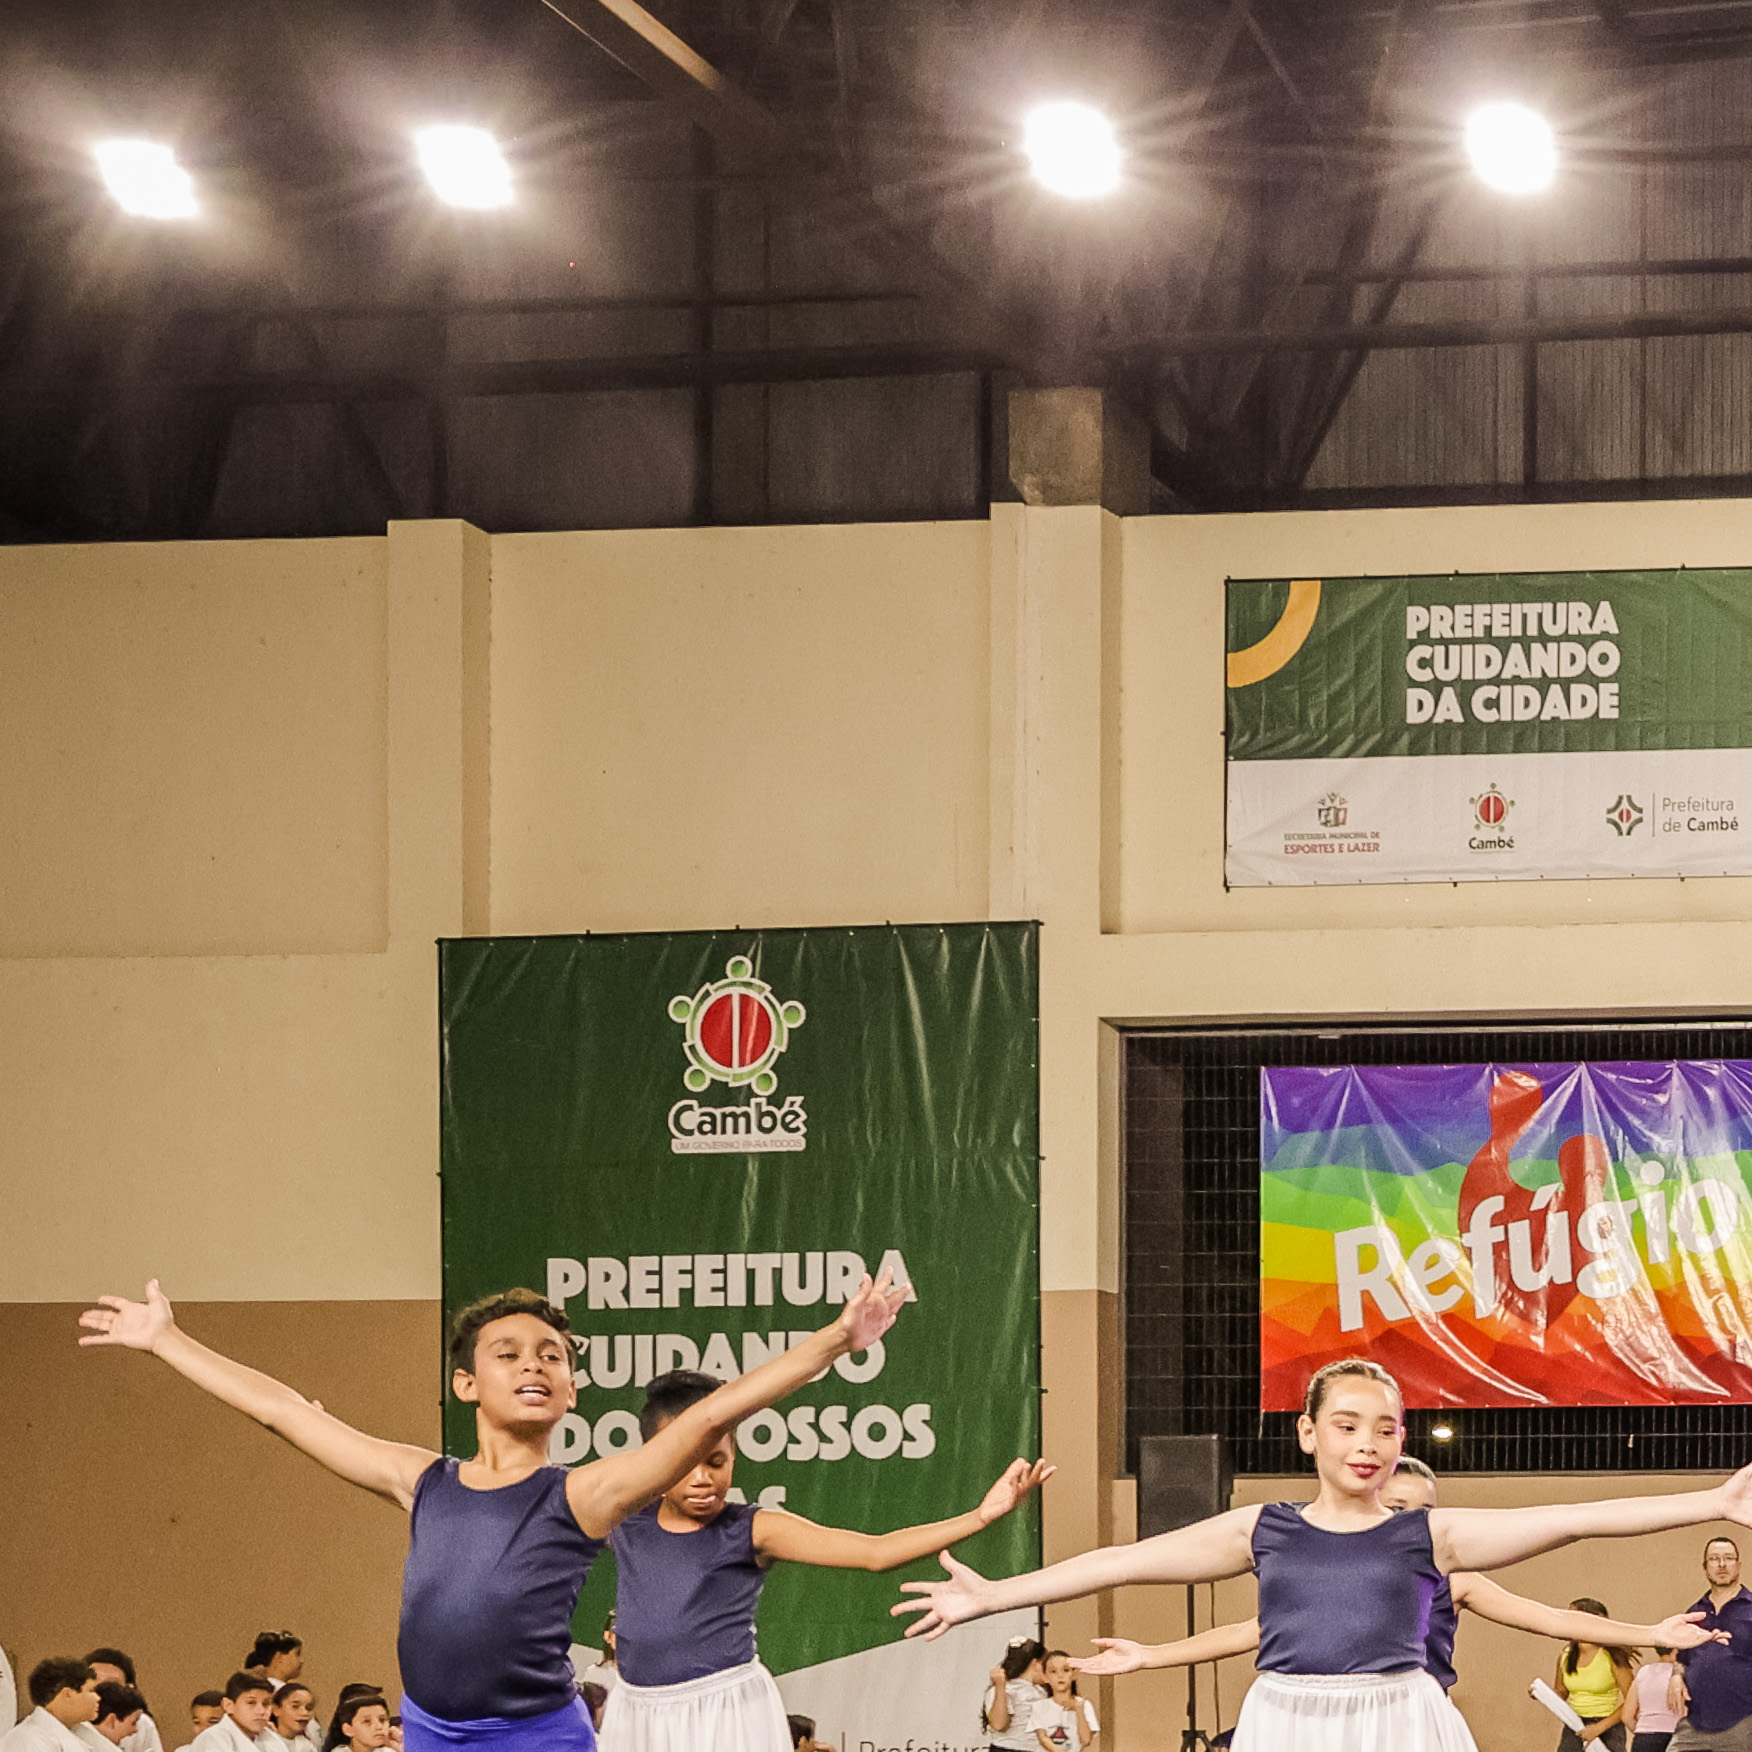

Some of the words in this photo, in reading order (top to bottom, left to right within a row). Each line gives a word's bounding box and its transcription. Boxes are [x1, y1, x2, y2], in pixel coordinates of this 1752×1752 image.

[1405, 601, 1619, 639] PREFEITURA
[1405, 640, 1621, 682] CUIDANDO
[1405, 686, 1465, 724] DA
[1471, 683, 1620, 723] CIDADE
[1662, 797, 1734, 812] Prefeitura
[1662, 817, 1681, 832] de
[1687, 816, 1739, 831] Cambé
[1284, 842, 1335, 854] ESPORTES
[1338, 843, 1345, 853] E
[1347, 842, 1380, 853] LAZER
[1468, 836, 1515, 851] Cambé
[670, 1097, 805, 1137] Cambé
[1334, 1160, 1739, 1333] Refúgio
[546, 1249, 918, 1310] PREFEITURA
[736, 1403, 937, 1463] OSSOS
